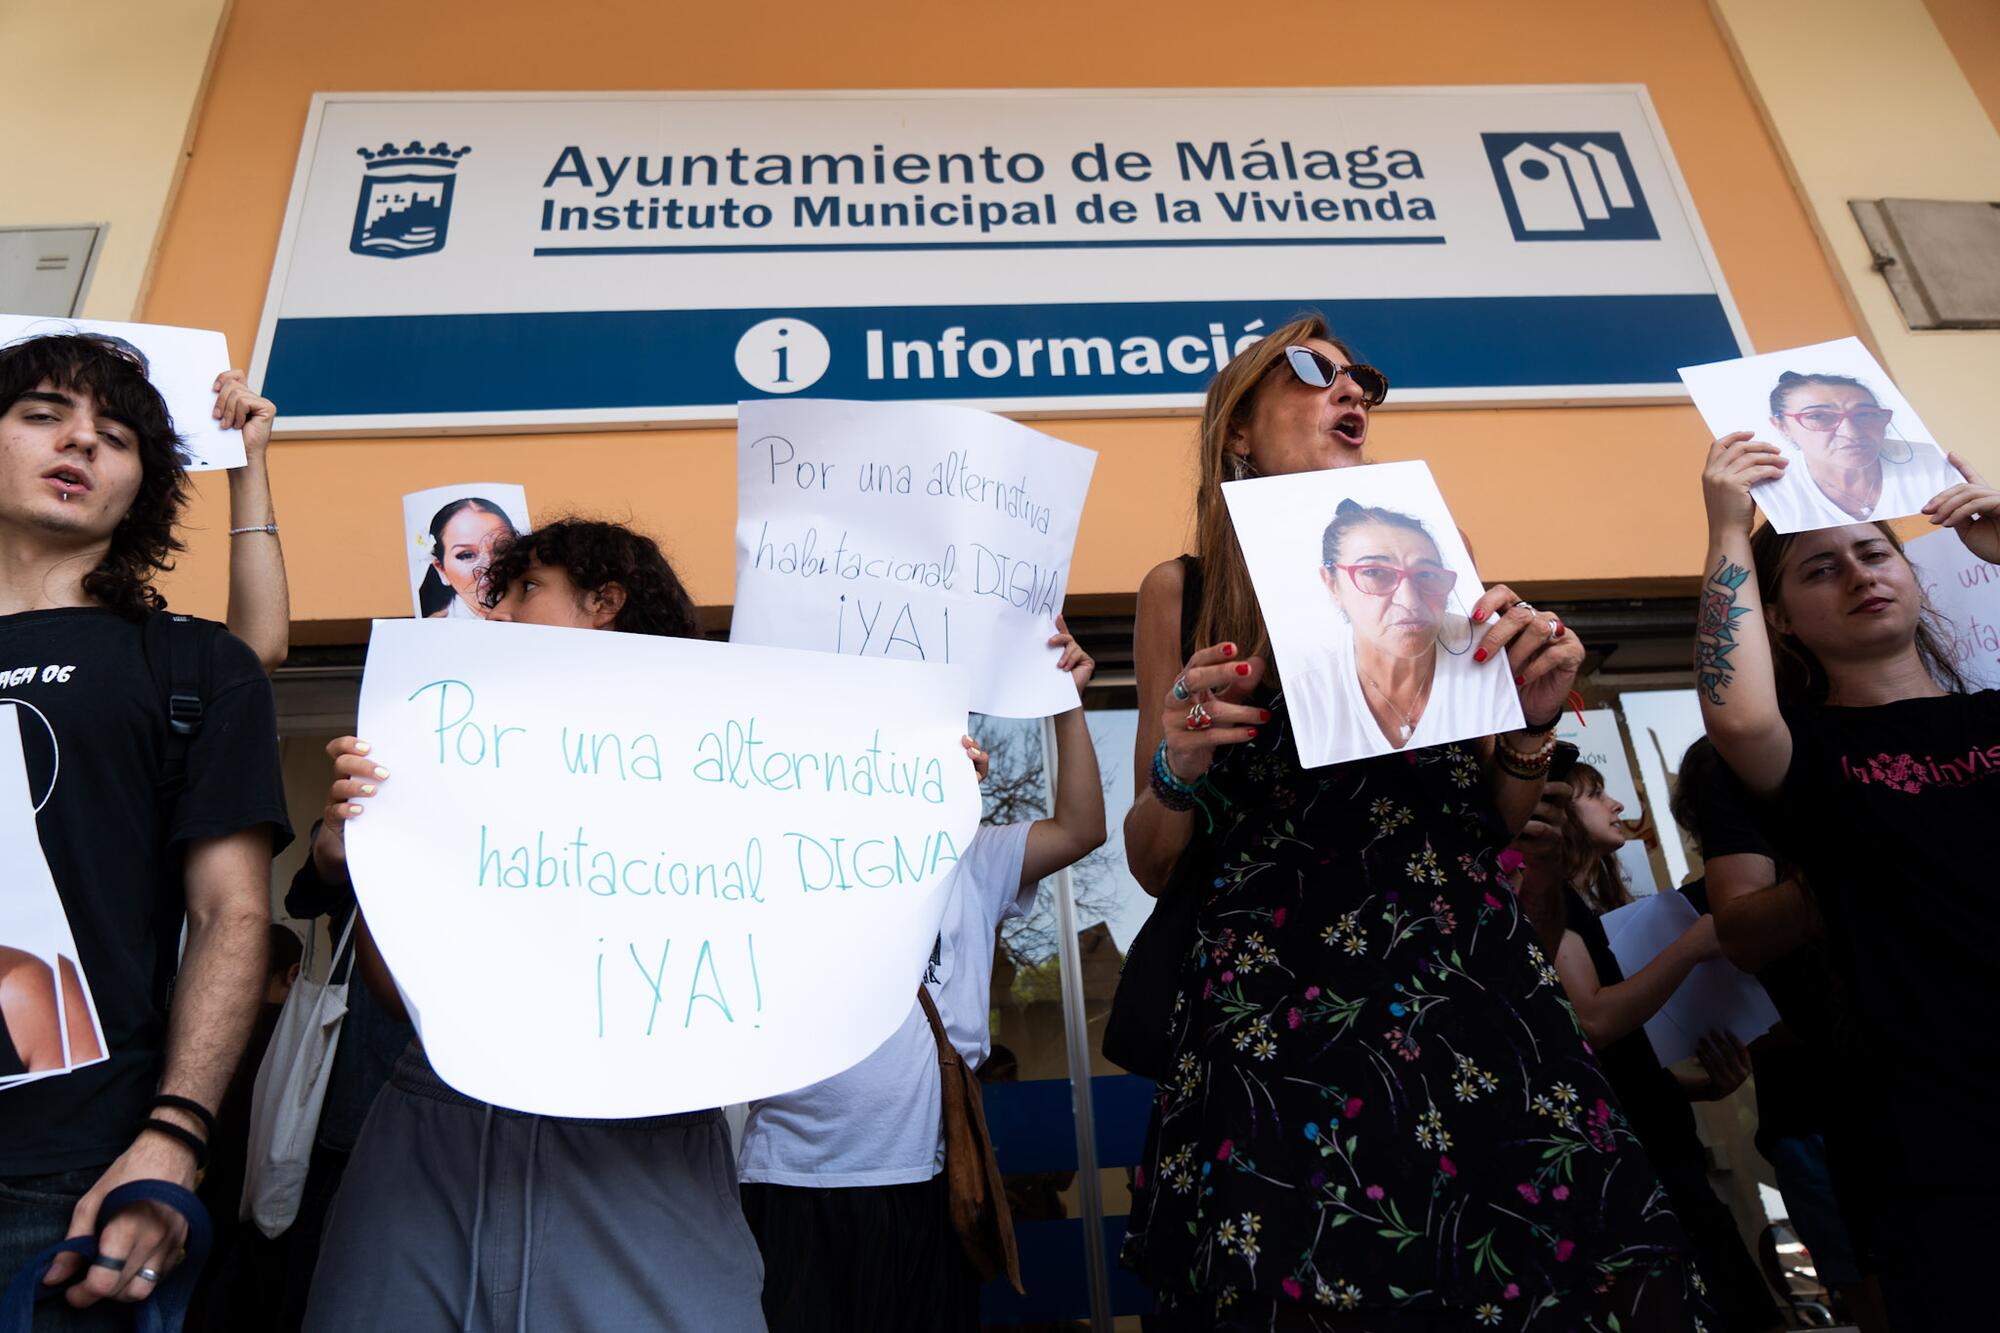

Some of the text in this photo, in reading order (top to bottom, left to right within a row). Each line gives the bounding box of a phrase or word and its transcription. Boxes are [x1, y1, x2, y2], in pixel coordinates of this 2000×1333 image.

[543, 138, 1425, 197] Ayuntamiento de Málaga
[541, 190, 1436, 233] Instituto Municipal de la Vivienda
[866, 319, 1265, 380] Informaci
[751, 435, 1050, 534] Por una alternativa
[755, 520, 1058, 620] habitacional DIGNA
[41, 664, 77, 684] 06
[408, 679, 945, 804] Por una alternativa
[478, 825, 959, 903] habitacional DIGNA
[597, 933, 763, 1038] ¡YA!
